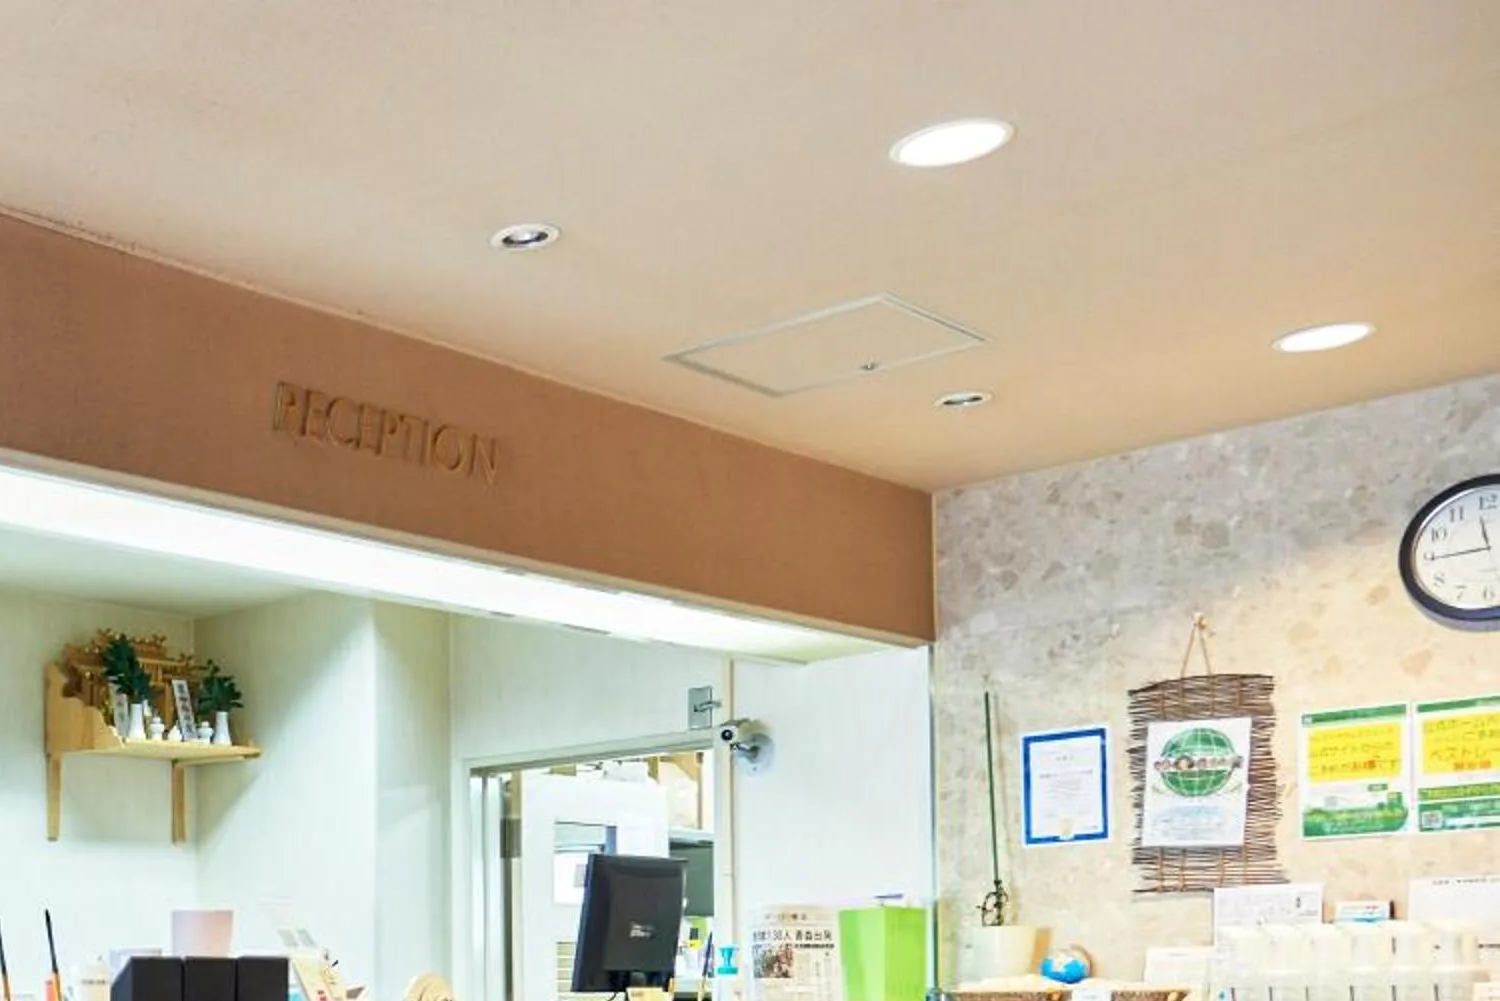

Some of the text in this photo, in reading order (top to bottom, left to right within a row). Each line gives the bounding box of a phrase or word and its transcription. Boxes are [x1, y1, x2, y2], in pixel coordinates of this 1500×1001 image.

[272, 380, 499, 485] RECEPTION
[1479, 493, 1498, 510] 12
[1450, 506, 1464, 523] 11
[1431, 526, 1448, 542] 10
[1455, 584, 1468, 600] 7
[1482, 584, 1496, 600] 6
